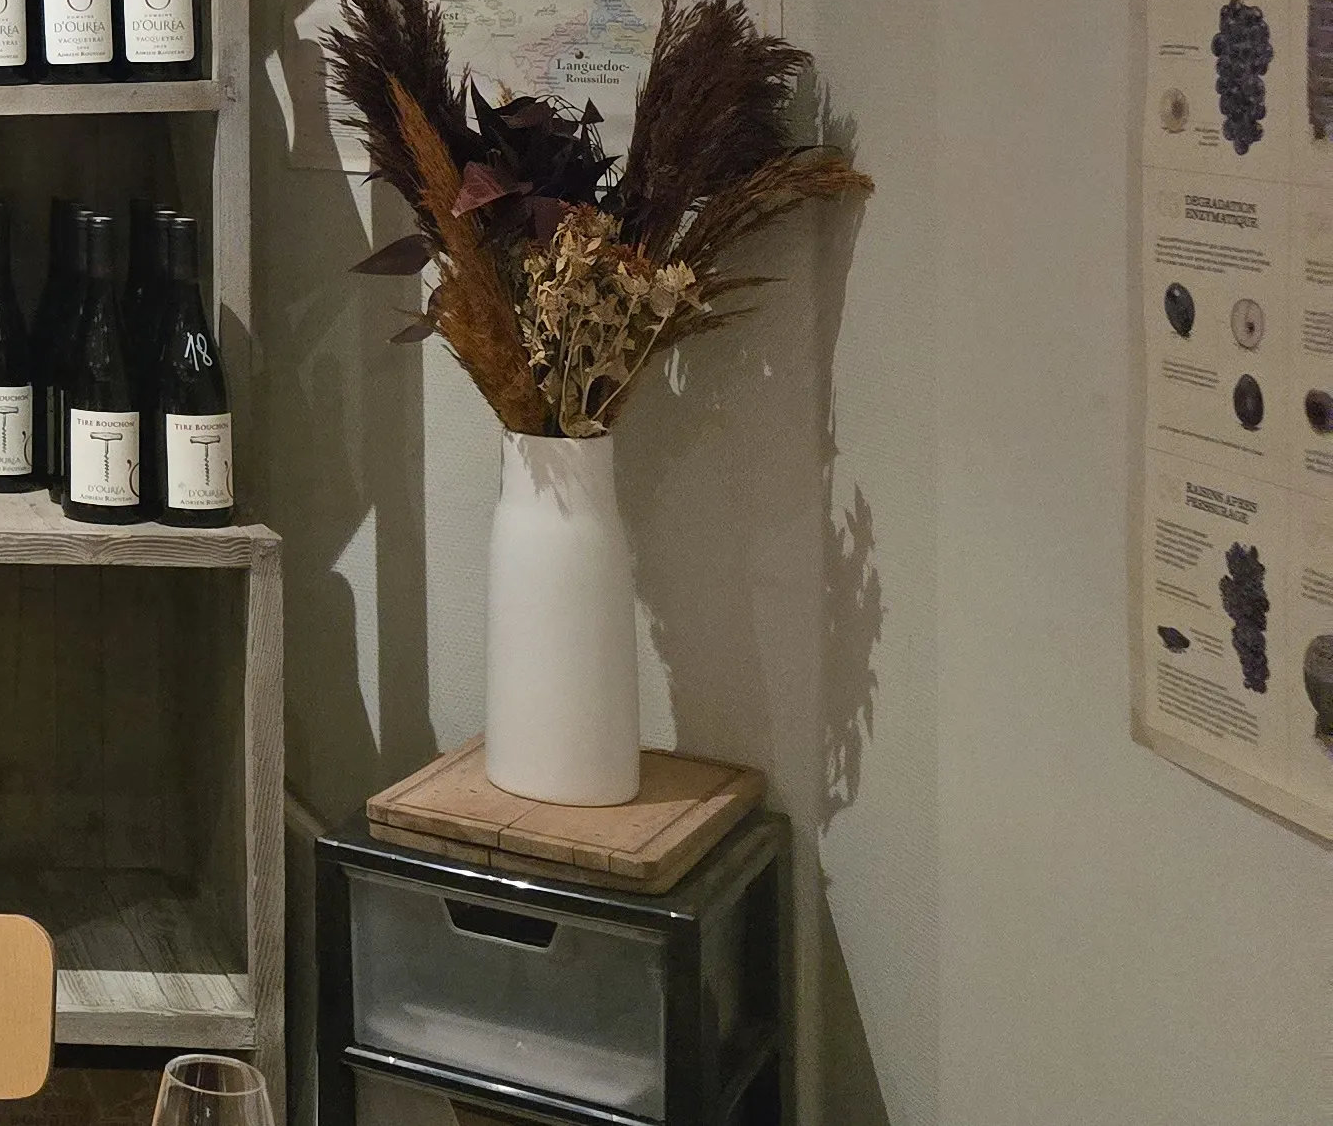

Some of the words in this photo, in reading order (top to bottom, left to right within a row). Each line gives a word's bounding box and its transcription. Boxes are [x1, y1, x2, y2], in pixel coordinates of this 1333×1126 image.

[556, 59, 630, 74] Languedoc-
[566, 74, 620, 84] Roussillon
[184, 331, 212, 371] 18
[174, 423, 192, 431] TIRE
